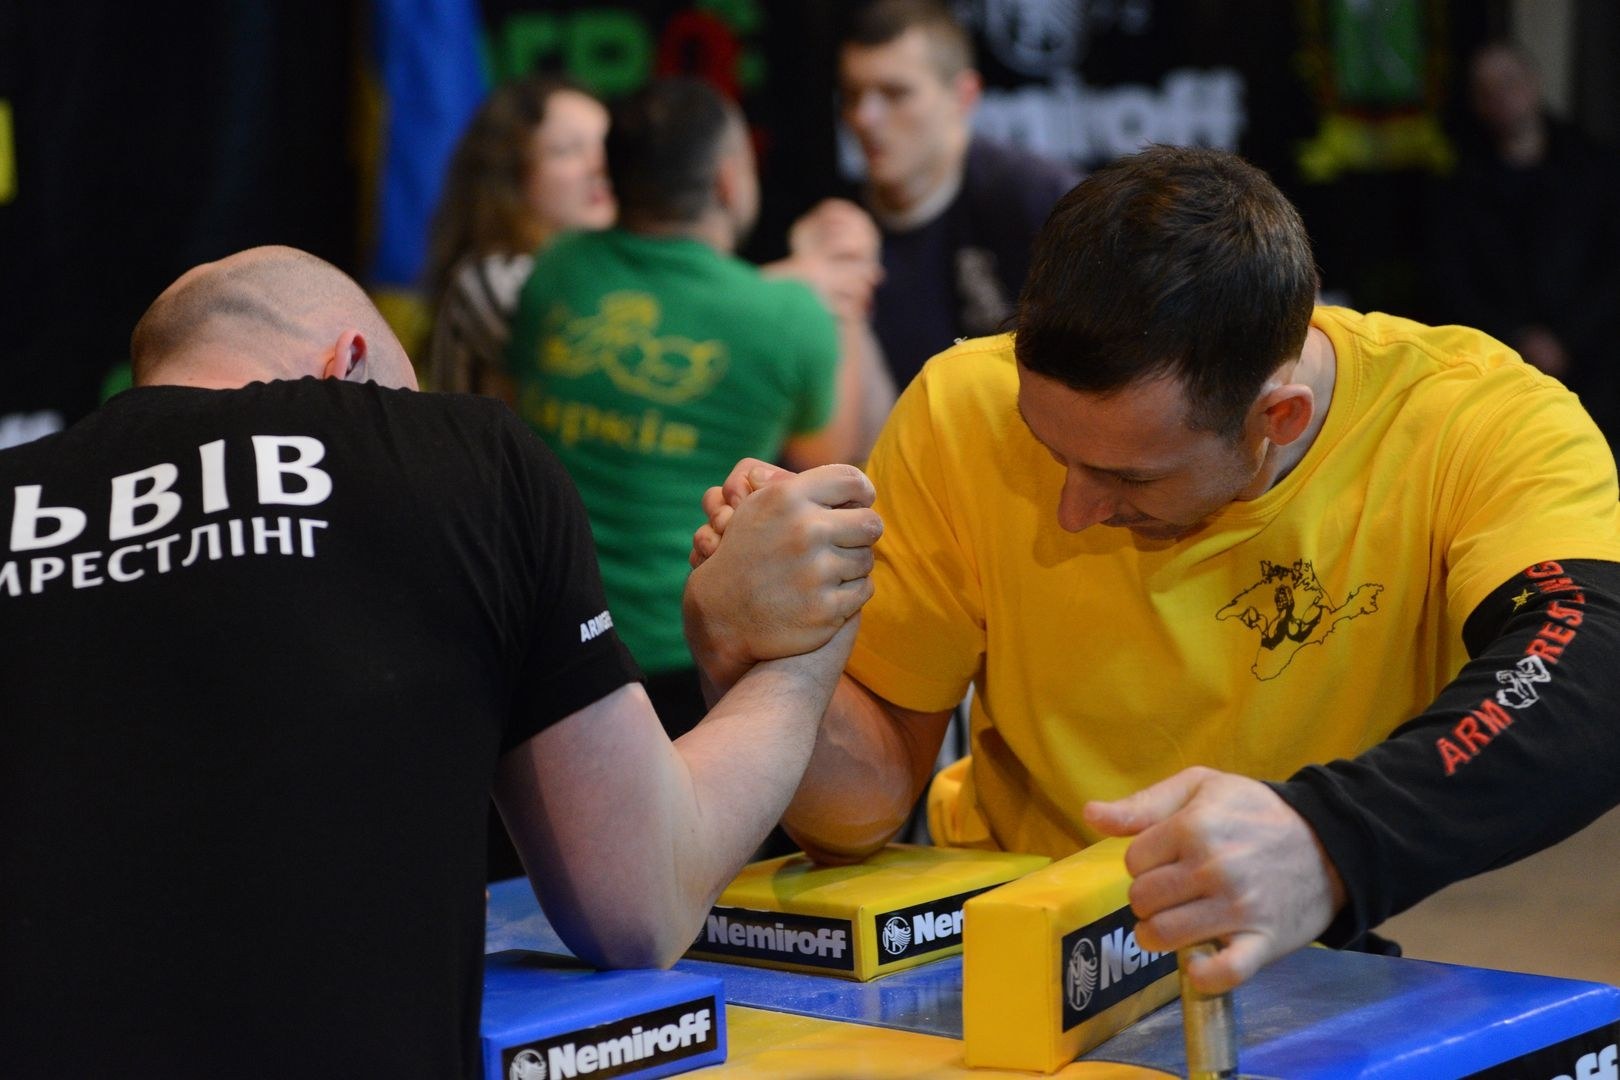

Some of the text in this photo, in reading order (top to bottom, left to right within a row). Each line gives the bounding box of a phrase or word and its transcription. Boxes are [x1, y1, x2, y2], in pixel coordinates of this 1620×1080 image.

[1436, 698, 1514, 777] ARM
[707, 914, 847, 959] Nemiroff
[1100, 926, 1176, 991] Ne
[547, 1008, 711, 1080] Nemiroff
